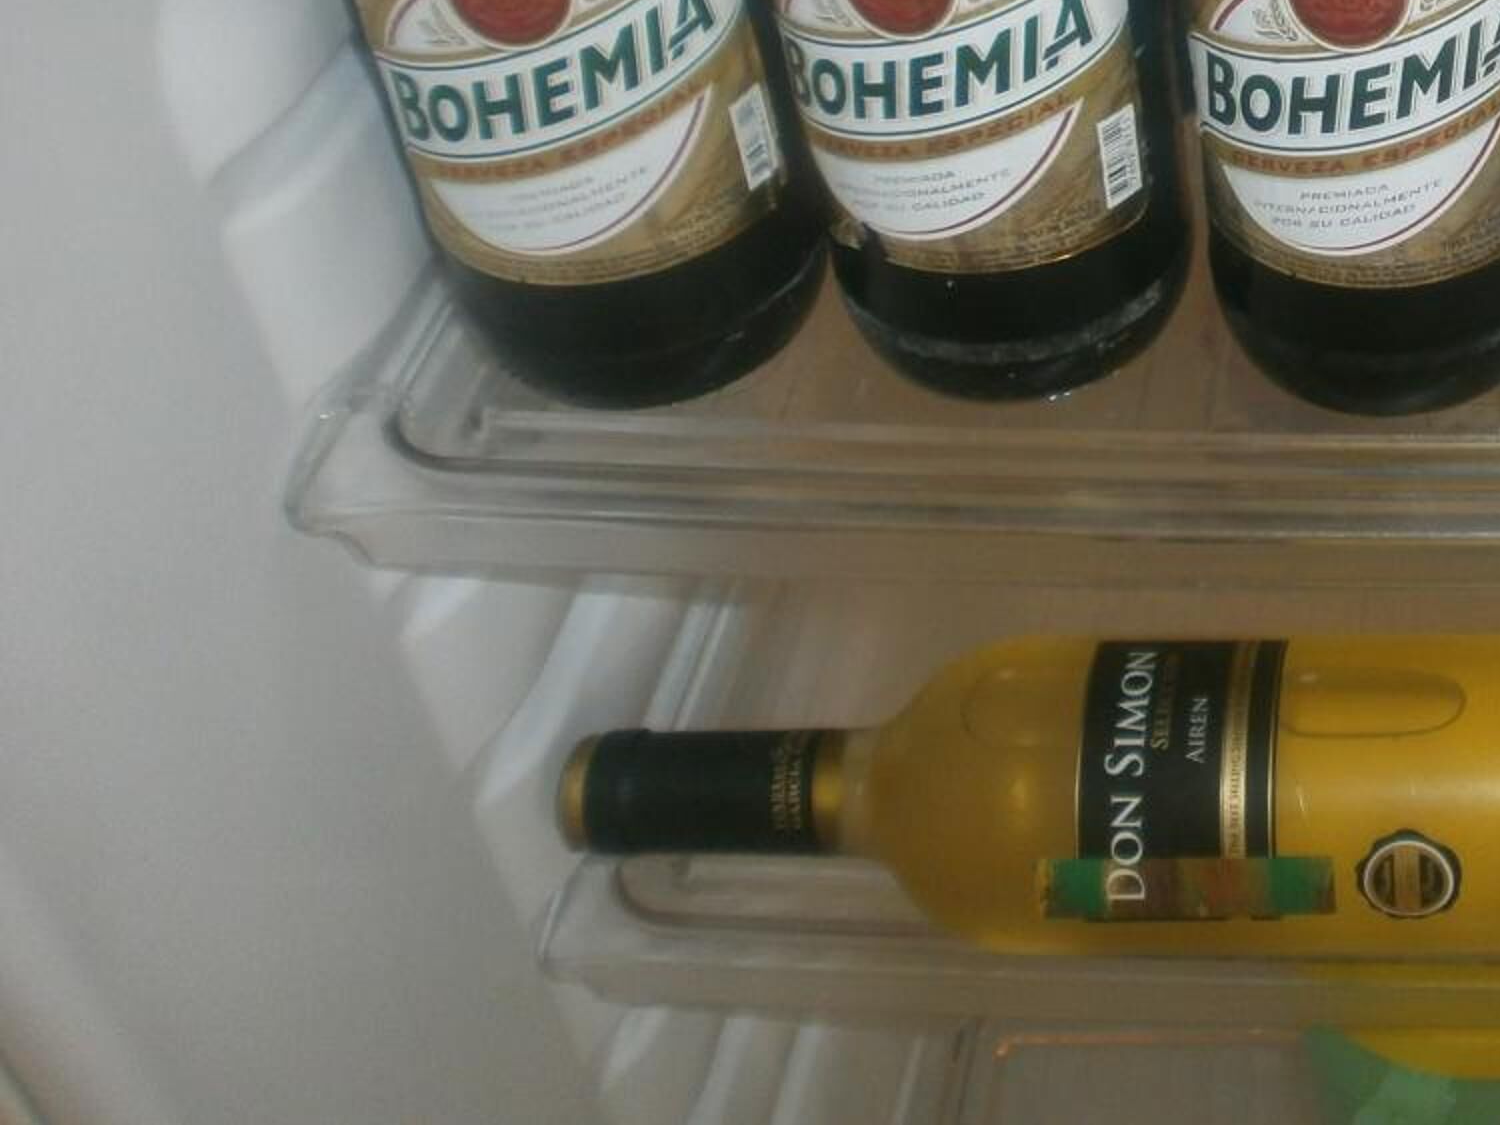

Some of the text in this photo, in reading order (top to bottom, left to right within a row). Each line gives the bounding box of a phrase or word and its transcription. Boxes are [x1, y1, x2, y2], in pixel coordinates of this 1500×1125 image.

[1104, 650, 1159, 905] DON SIMON
[1184, 696, 1209, 764] AIREN
